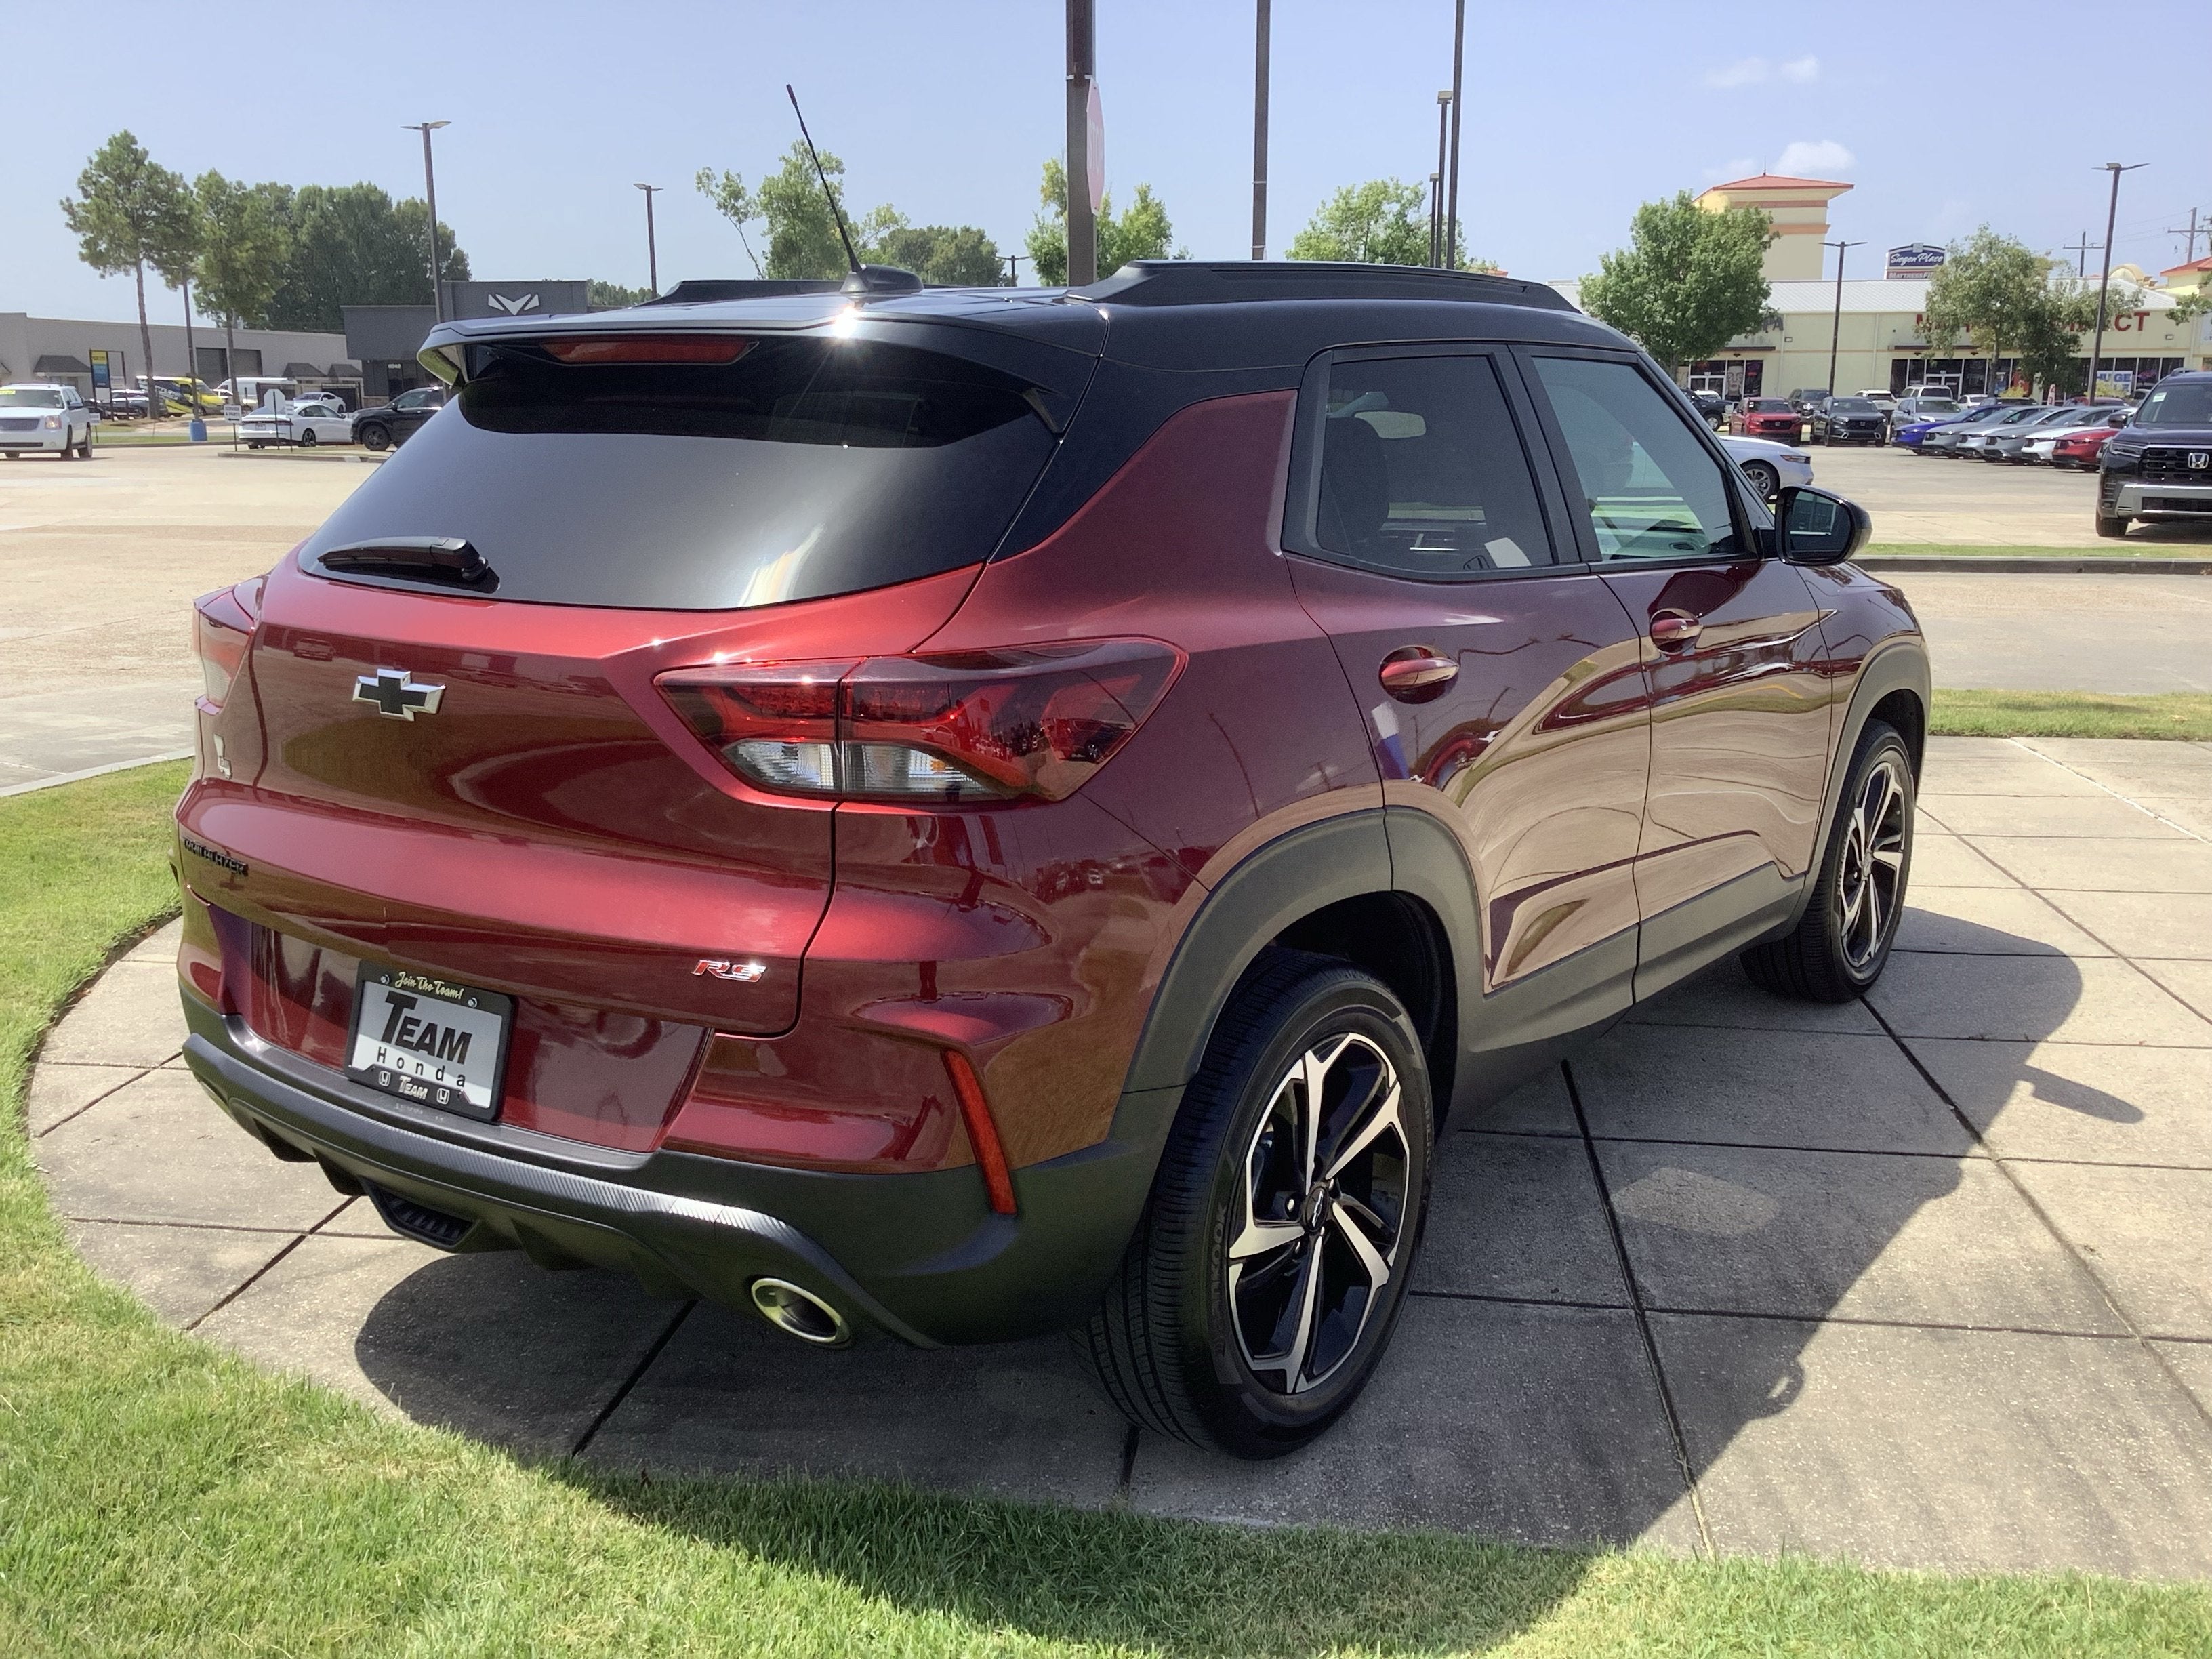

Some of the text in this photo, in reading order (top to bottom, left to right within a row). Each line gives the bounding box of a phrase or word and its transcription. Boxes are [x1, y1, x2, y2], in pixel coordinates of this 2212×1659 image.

[1917, 253, 1944, 262] Place
[691, 959, 766, 983] RS
[395, 971, 464, 1000] Join The Team!
[381, 990, 472, 1065] TEAM
[377, 1046, 465, 1087] Honda
[398, 1075, 428, 1099] TEAM
